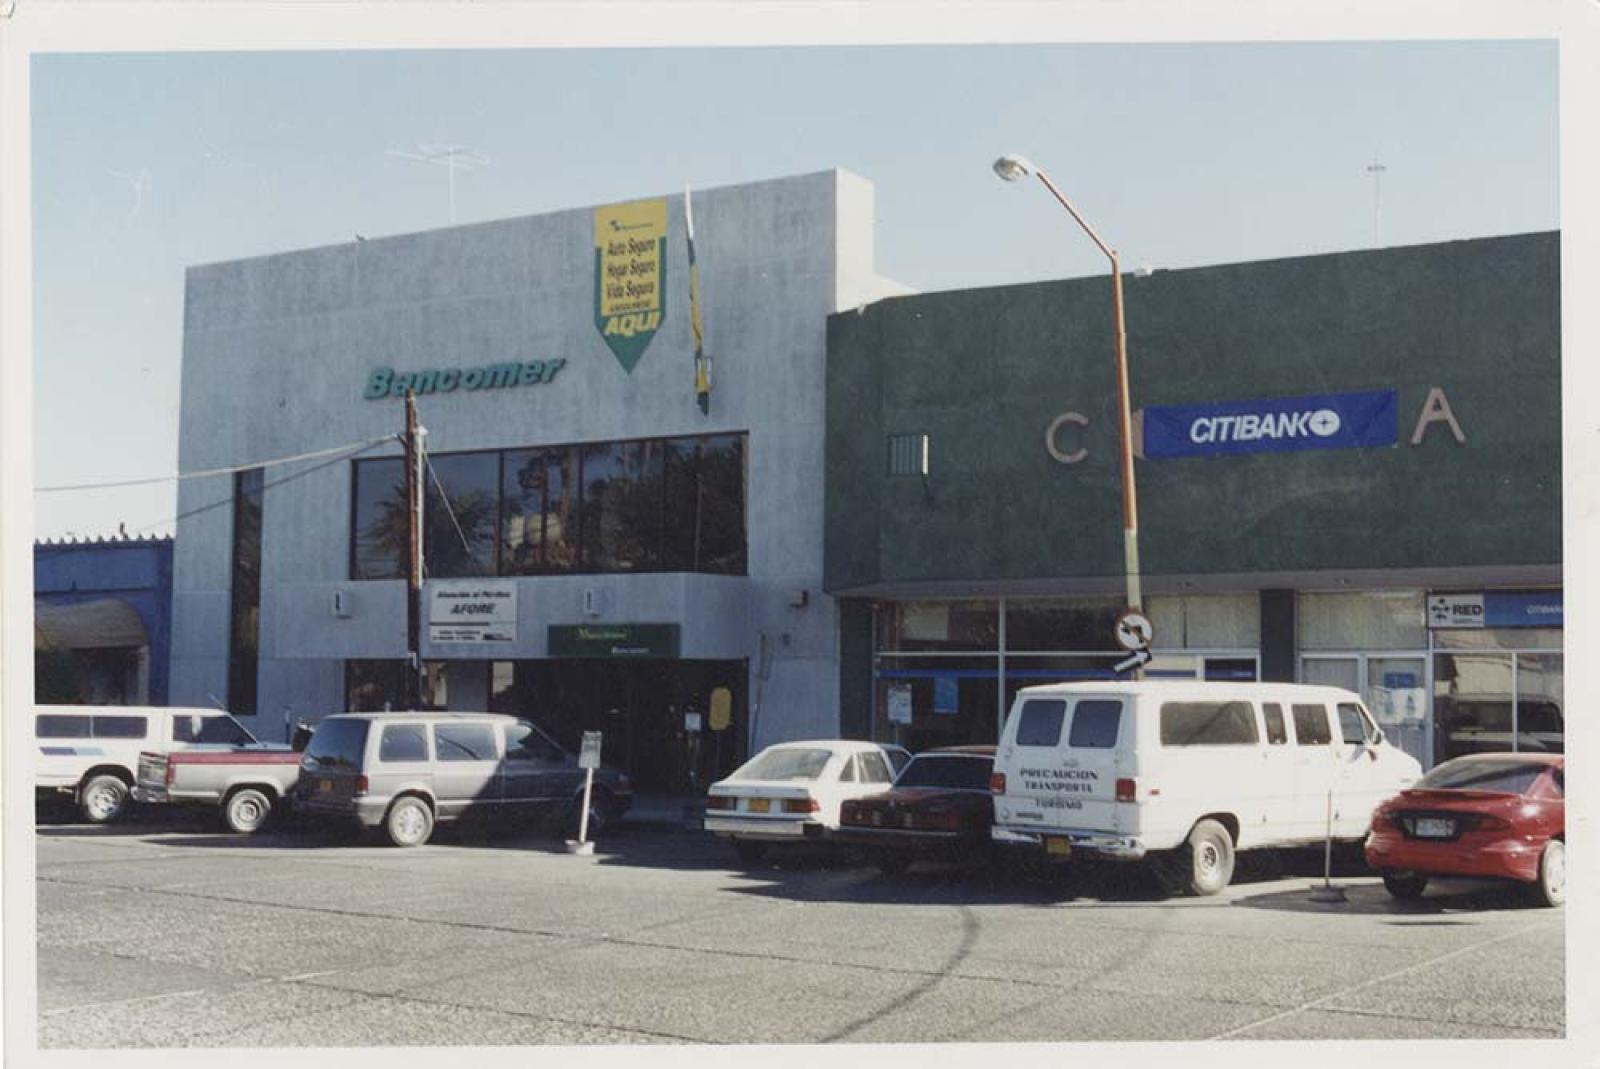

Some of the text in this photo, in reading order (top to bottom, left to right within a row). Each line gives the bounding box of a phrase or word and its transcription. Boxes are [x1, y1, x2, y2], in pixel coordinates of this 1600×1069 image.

[628, 237, 655, 257] Seguro
[604, 311, 660, 337] AQUI
[364, 357, 567, 400] Bancomer
[1190, 409, 1310, 443] CITIBANK
[1411, 387, 1466, 446] A
[1046, 412, 1089, 464] C
[450, 603, 497, 615] AFORE
[1452, 603, 1483, 616] RED
[1019, 767, 1098, 781] PRECAUCION
